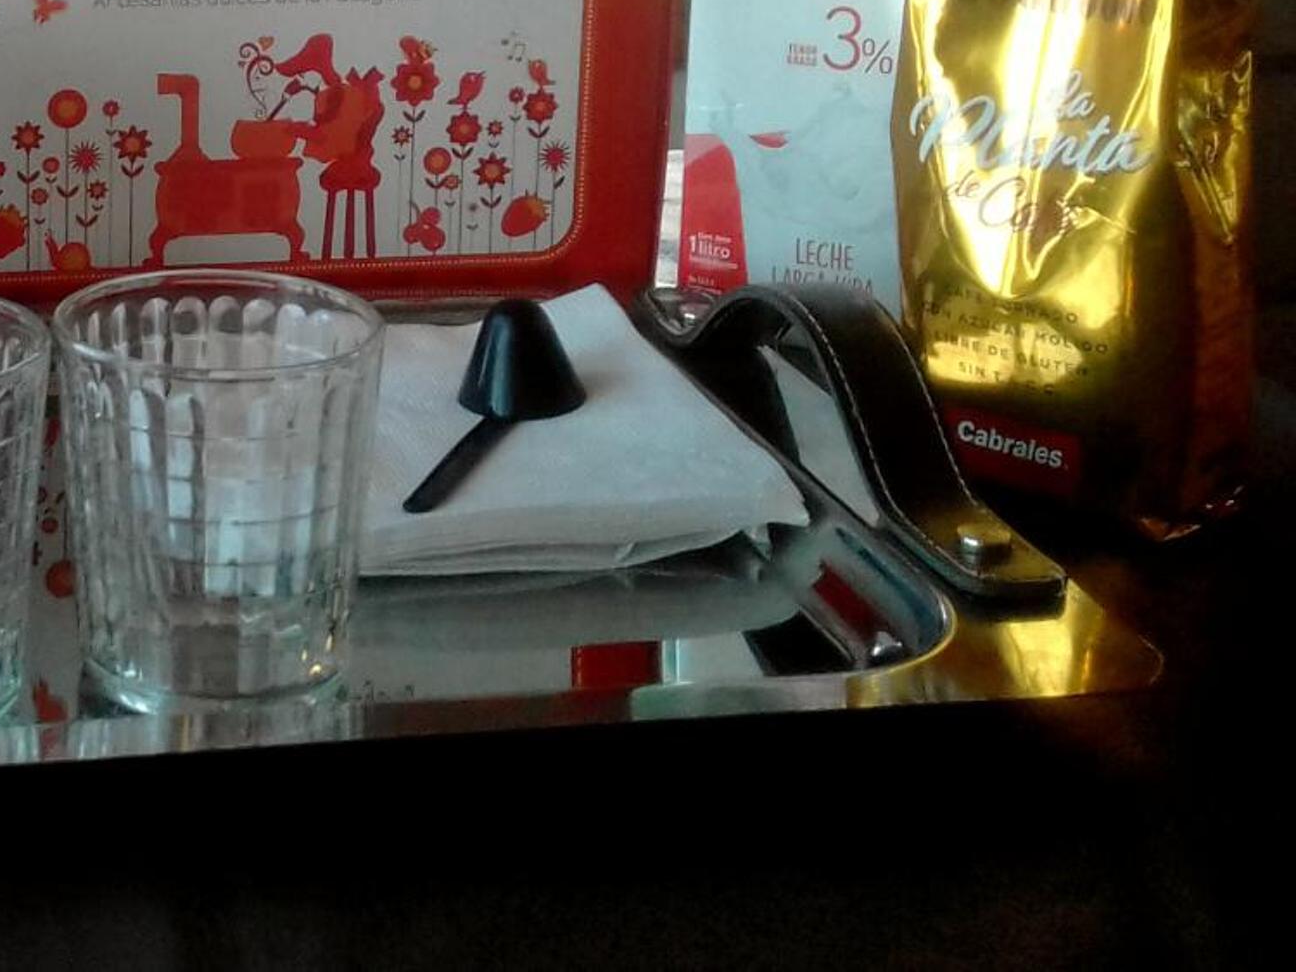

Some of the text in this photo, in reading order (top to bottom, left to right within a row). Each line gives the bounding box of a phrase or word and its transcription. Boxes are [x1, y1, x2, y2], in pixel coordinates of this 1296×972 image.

[822, 5, 893, 75] 3%
[796, 237, 856, 270] LECHE
[1035, 326, 1108, 355] MOLDO
[957, 419, 1064, 469] Cabrales
